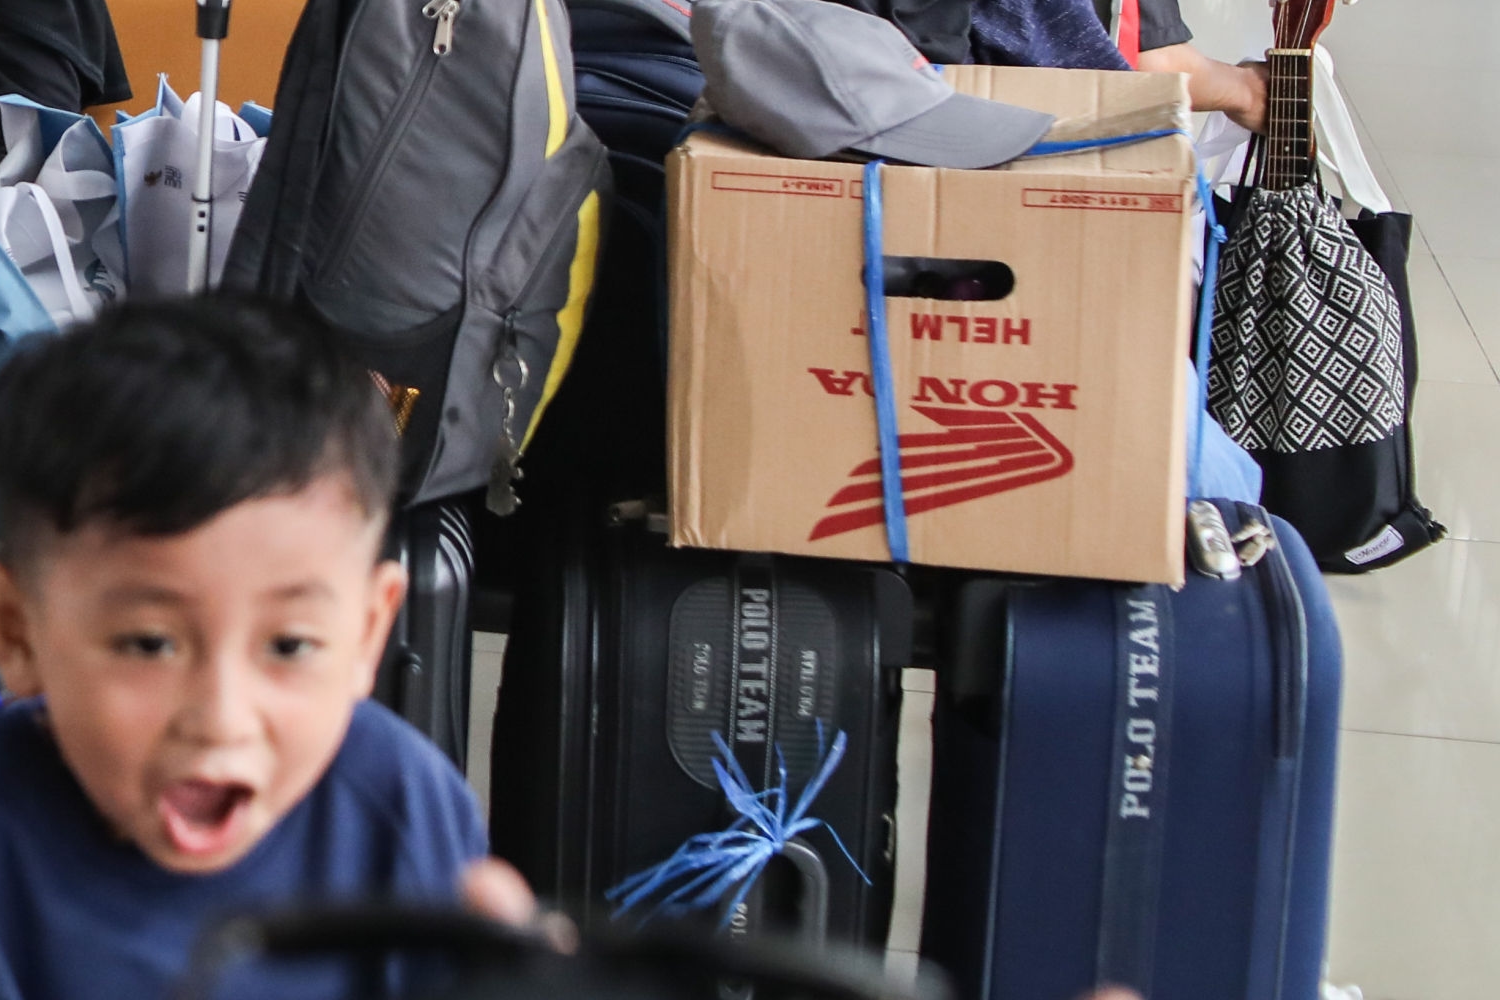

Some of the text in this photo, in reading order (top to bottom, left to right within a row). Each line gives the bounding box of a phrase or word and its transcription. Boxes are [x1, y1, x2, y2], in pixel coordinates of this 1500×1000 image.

[808, 367, 1078, 411] HONA
[736, 588, 771, 744] POLO TEAM
[797, 650, 818, 717] POLO TEAM
[1119, 598, 1160, 820] POLO TEAM
